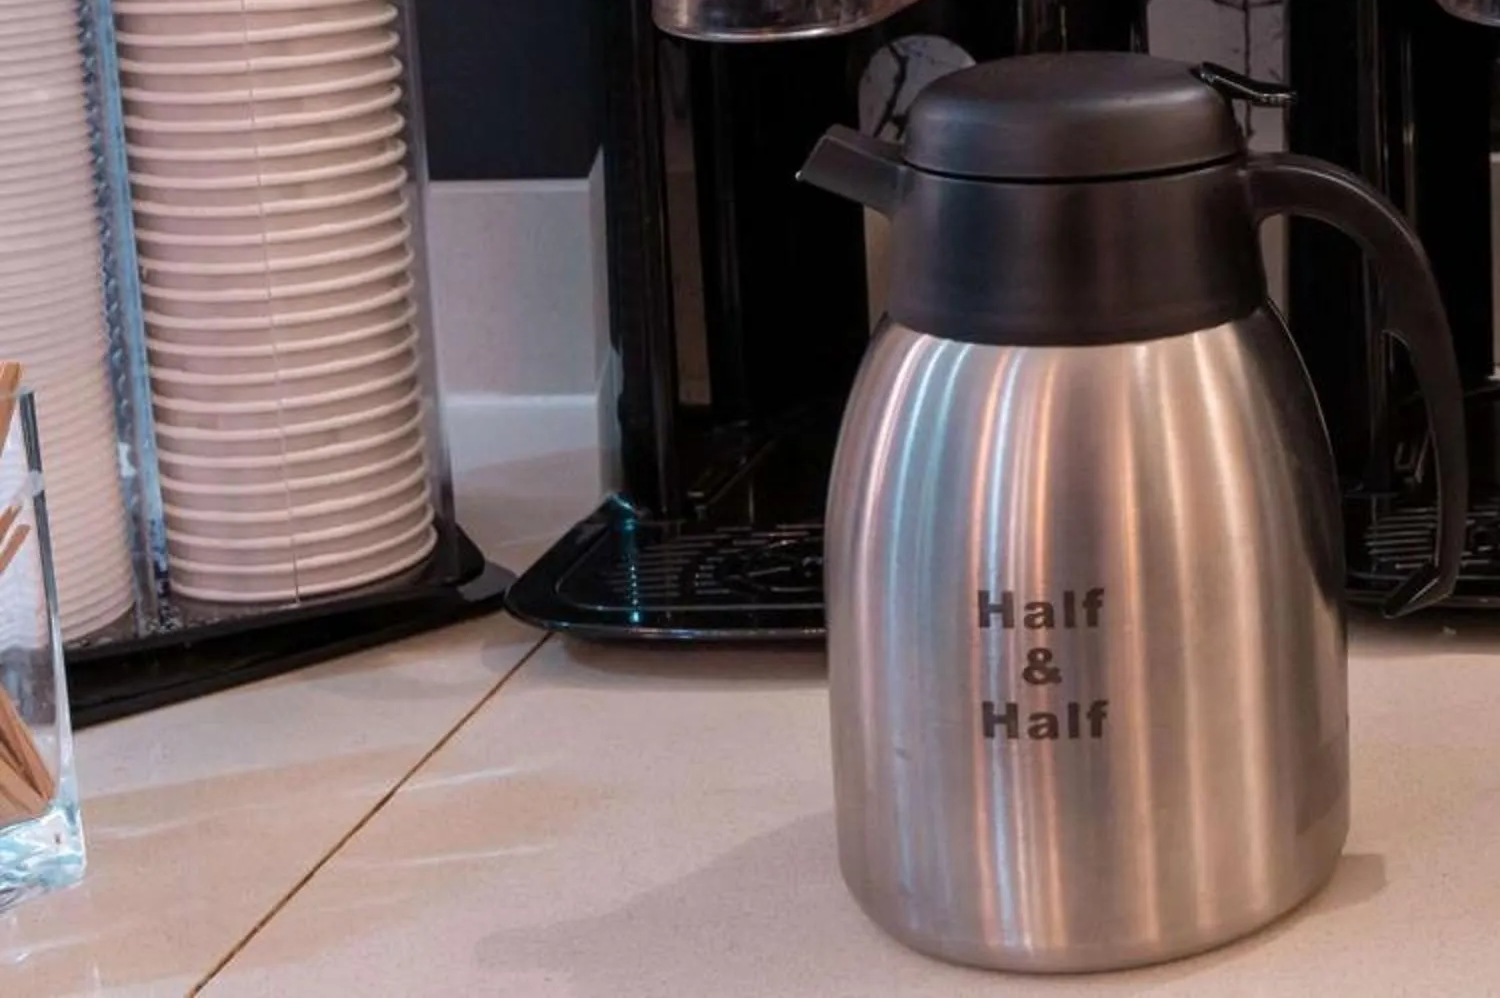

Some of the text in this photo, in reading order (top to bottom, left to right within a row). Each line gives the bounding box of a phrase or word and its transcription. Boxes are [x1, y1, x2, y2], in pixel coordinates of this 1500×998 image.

[977, 587, 1105, 629] Half
[1022, 647, 1062, 685] &
[981, 699, 1109, 740] Half
